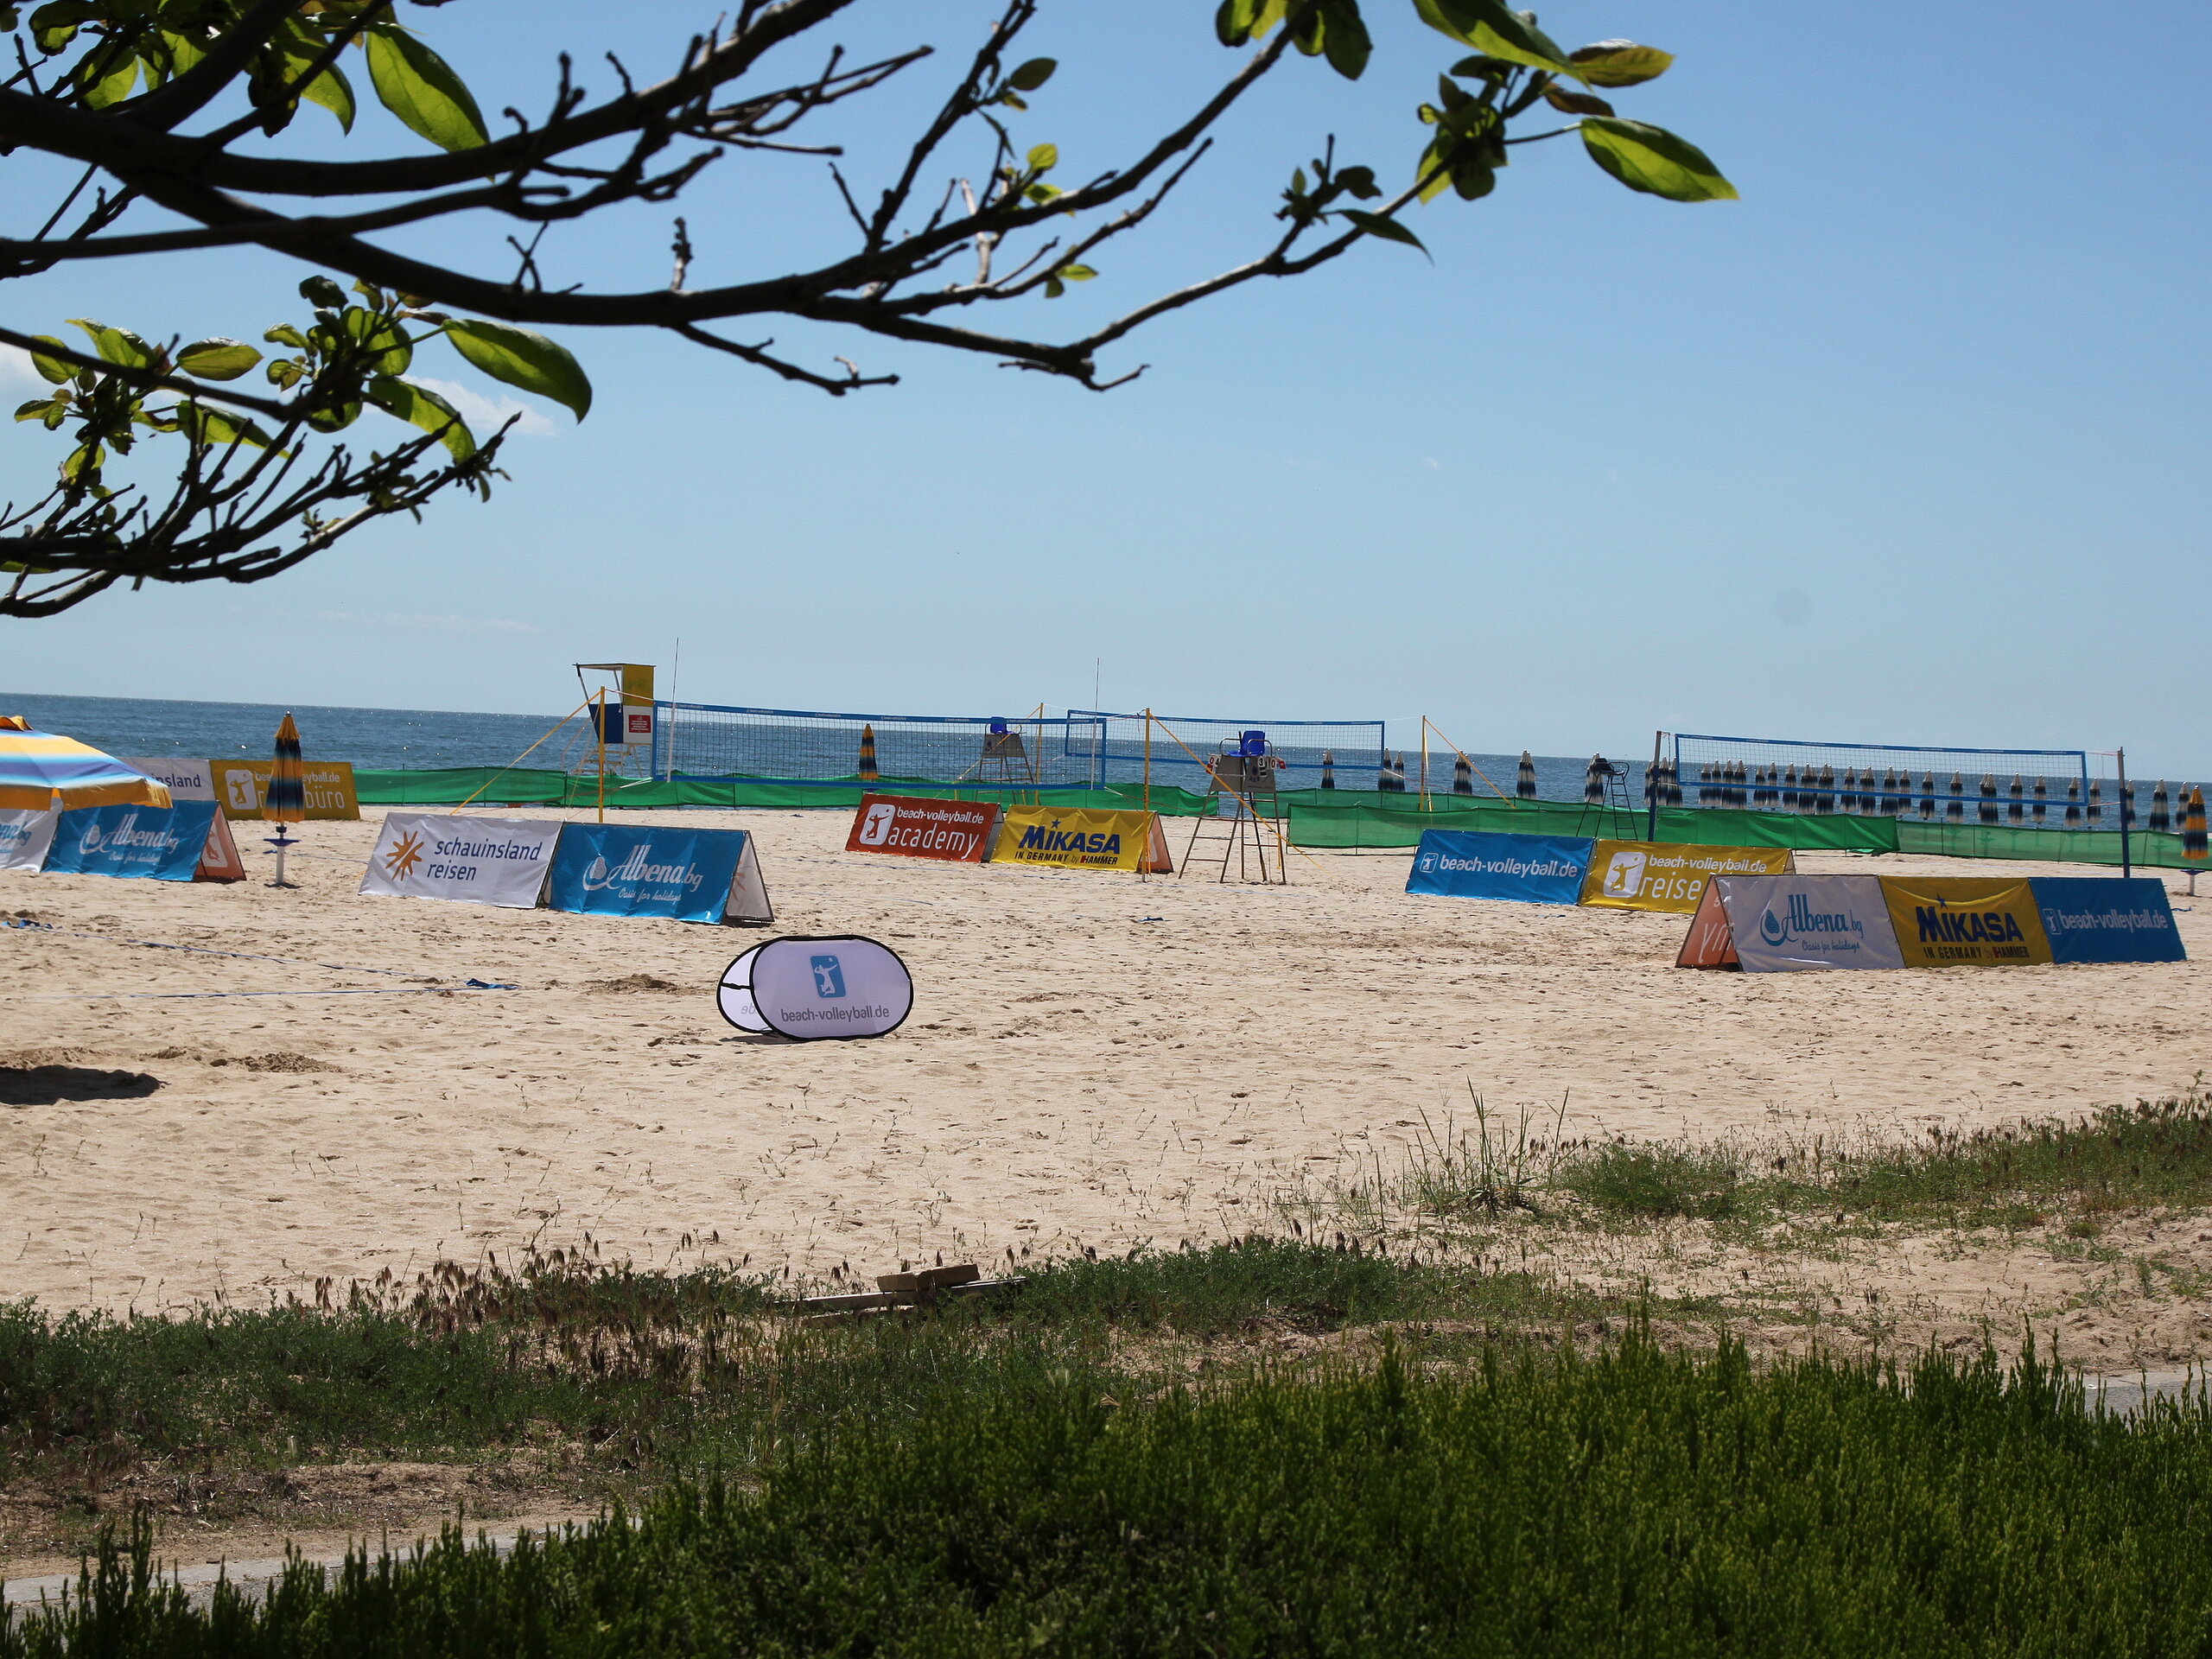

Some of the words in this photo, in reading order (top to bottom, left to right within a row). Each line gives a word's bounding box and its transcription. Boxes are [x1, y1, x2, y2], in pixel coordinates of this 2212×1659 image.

[897, 806, 984, 824] beach-volleyball.de
[434, 836, 543, 861] schauinsland
[887, 823, 980, 860] academy
[1018, 824, 1121, 855] MIKASA
[1014, 851, 1025, 860] IN
[1027, 851, 1069, 862] GERMANY
[1071, 855, 1080, 864] by
[1080, 855, 1118, 865] HAMMER
[1440, 854, 1578, 879] beach-volleyball.de
[1649, 854, 1767, 873] beach-volleyball.de
[427, 860, 477, 881] reisen
[637, 887, 650, 903] for
[1638, 871, 1702, 901] reise
[1916, 906, 2024, 943] MIKASA
[2057, 909, 2169, 933] beach-volleyball.de
[1923, 946, 1936, 959] IN
[1937, 946, 1982, 959] GERMANY
[780, 1005, 890, 1024] beach-volleyball.de
